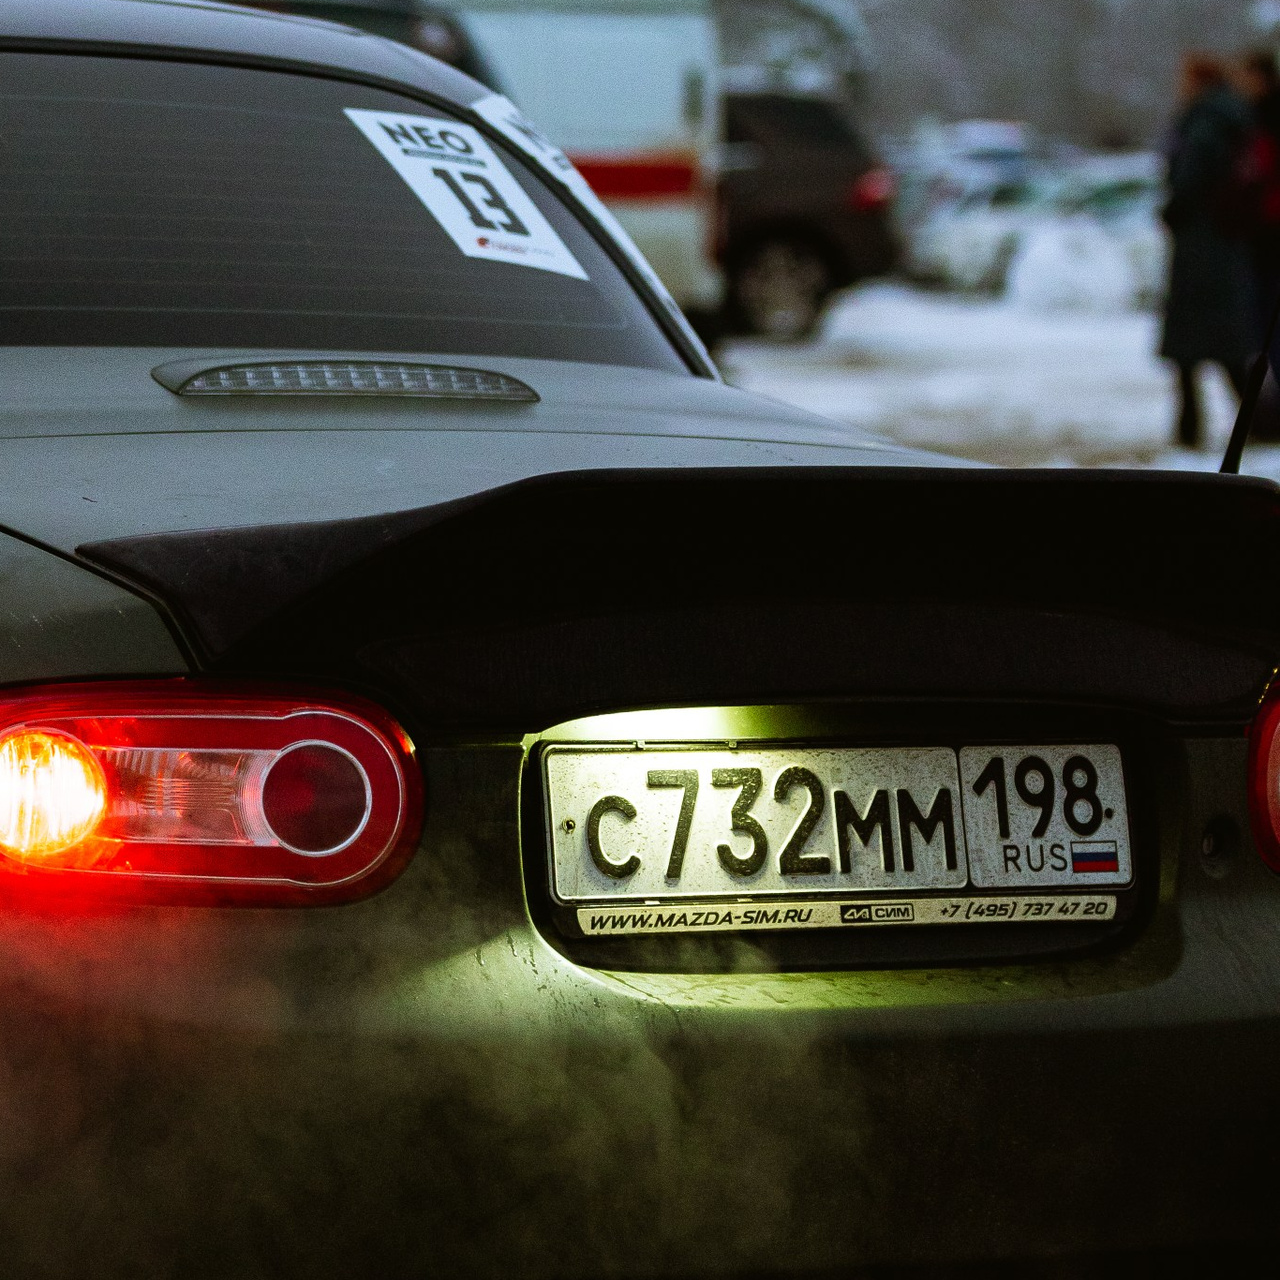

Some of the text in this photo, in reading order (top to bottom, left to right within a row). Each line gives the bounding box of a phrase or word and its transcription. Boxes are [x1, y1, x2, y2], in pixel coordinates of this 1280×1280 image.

[377, 120, 475, 155] NEO
[431, 167, 531, 237] 13
[971, 755, 1100, 839] 198
[1003, 843, 1068, 873] RUS
[590, 908, 813, 930] WWW.MAZDA-SIM.RU
[875, 907, 910, 918] СИМ
[940, 901, 1109, 919] +7 (495) 737 47 20
